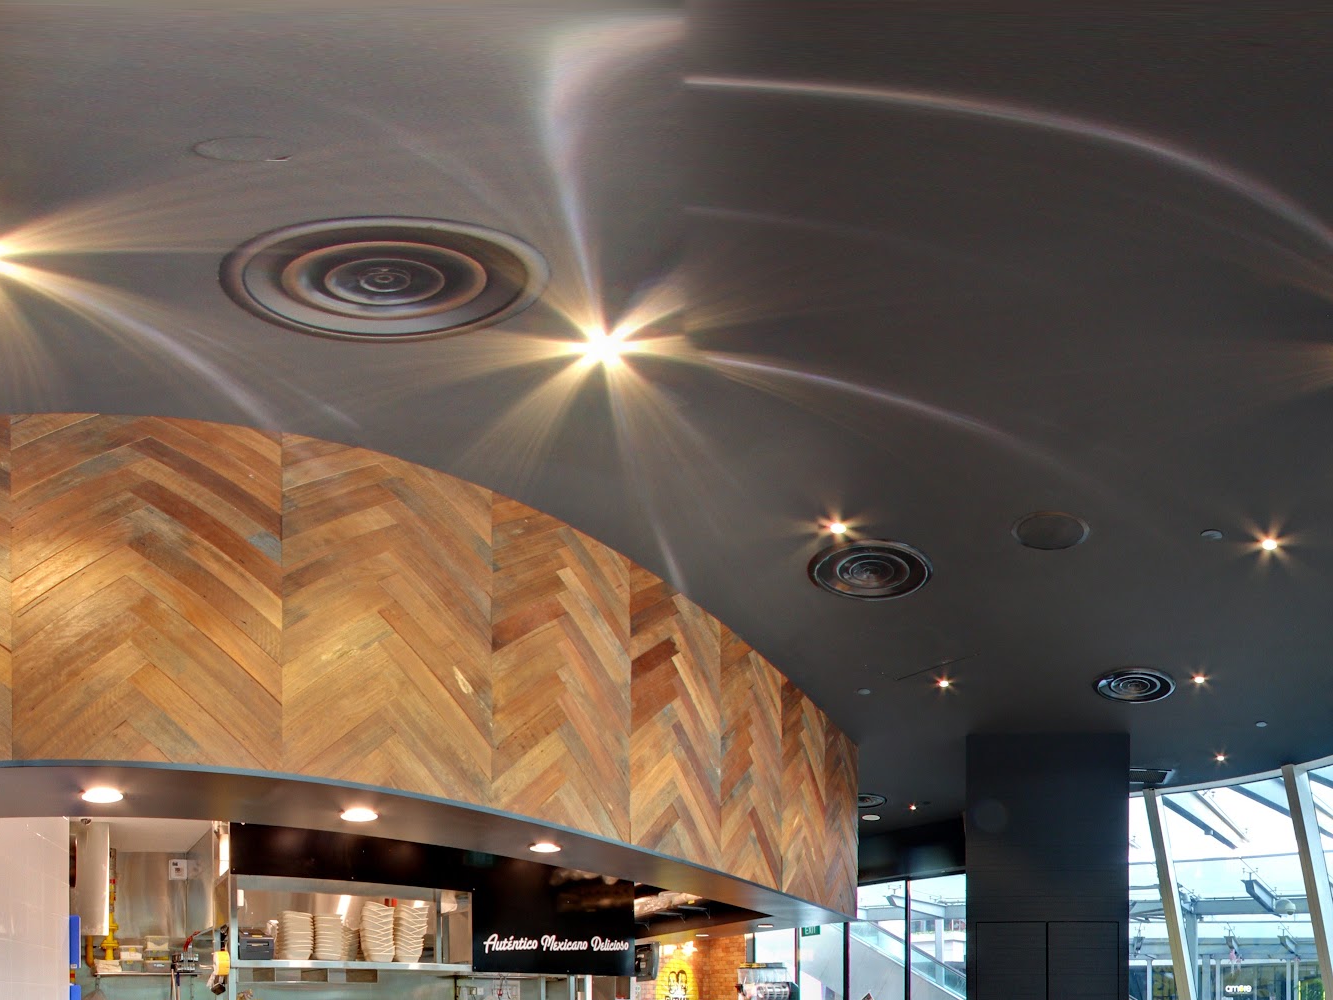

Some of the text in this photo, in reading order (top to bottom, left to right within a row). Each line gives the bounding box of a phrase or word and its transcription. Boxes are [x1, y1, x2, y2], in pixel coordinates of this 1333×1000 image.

[483, 933, 630, 954] Auténtico Mexicano Delicioso
